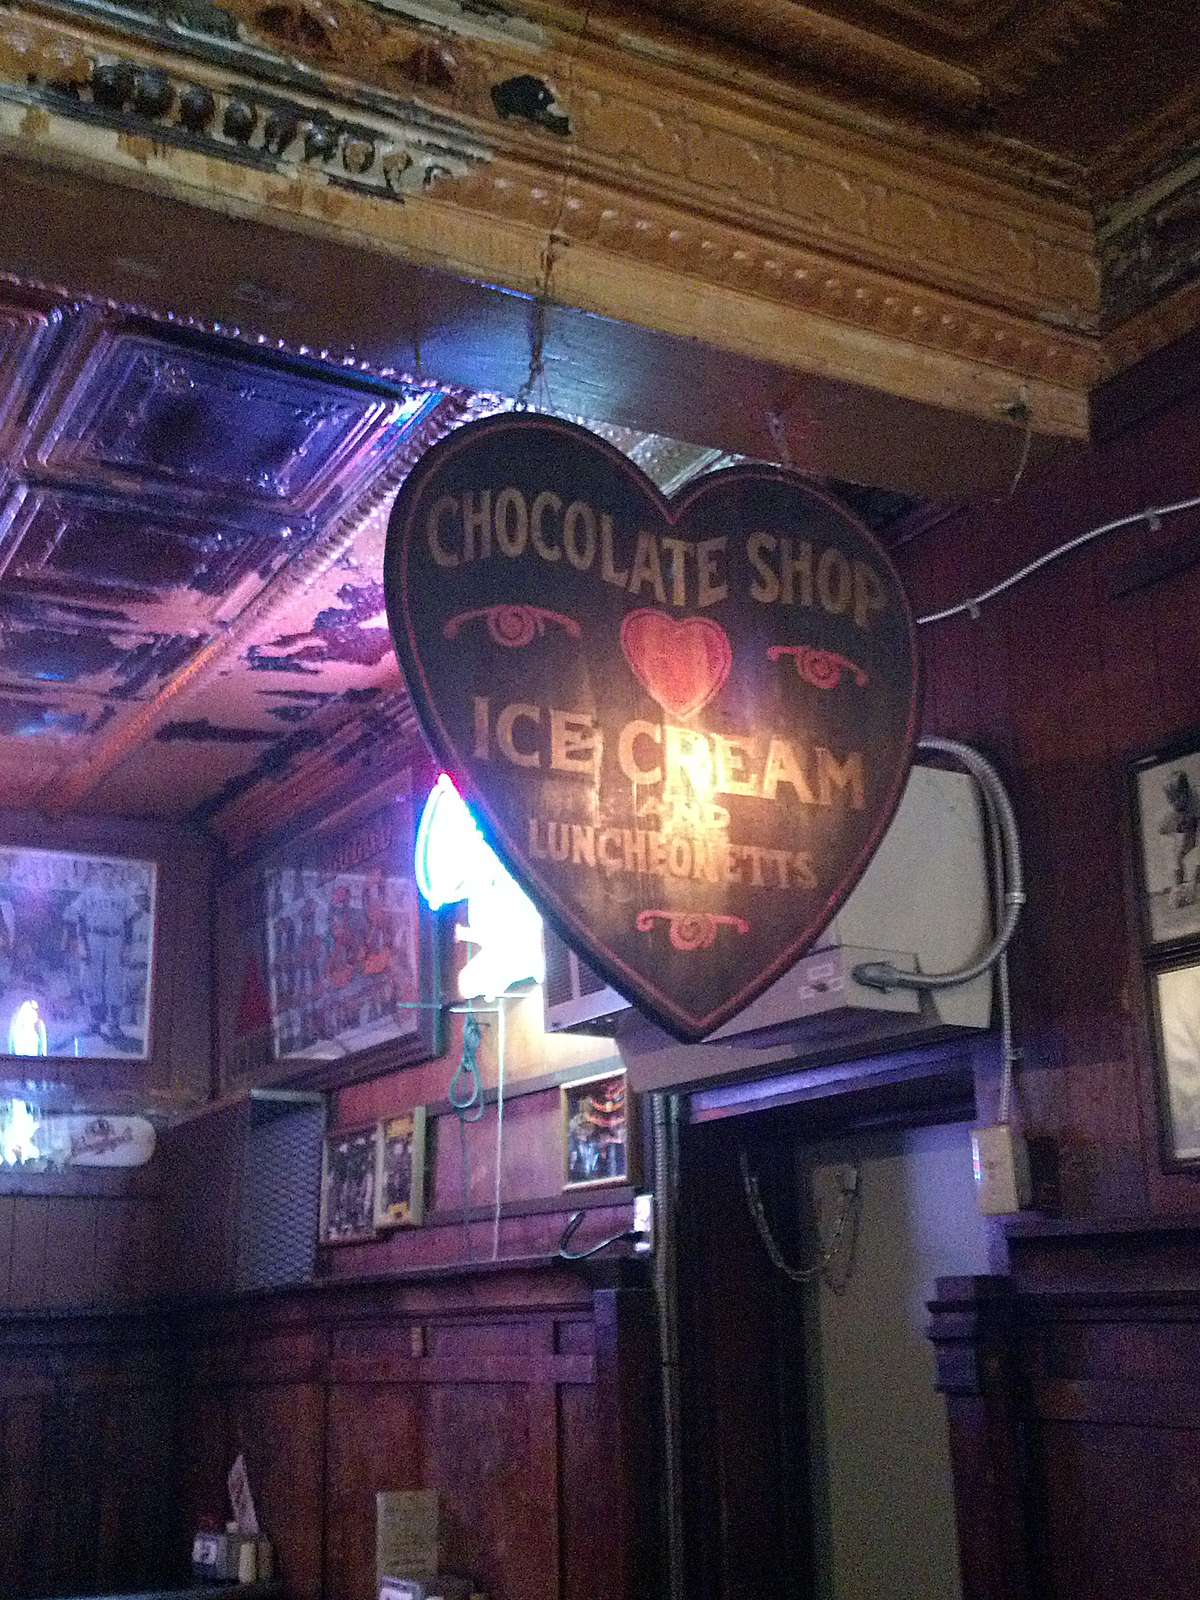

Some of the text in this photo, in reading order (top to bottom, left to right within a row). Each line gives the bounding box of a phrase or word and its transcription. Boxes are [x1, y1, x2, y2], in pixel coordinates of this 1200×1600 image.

[426, 486, 888, 630] CHOCOLATE SHOP
[471, 696, 866, 810] ICE CREAM
